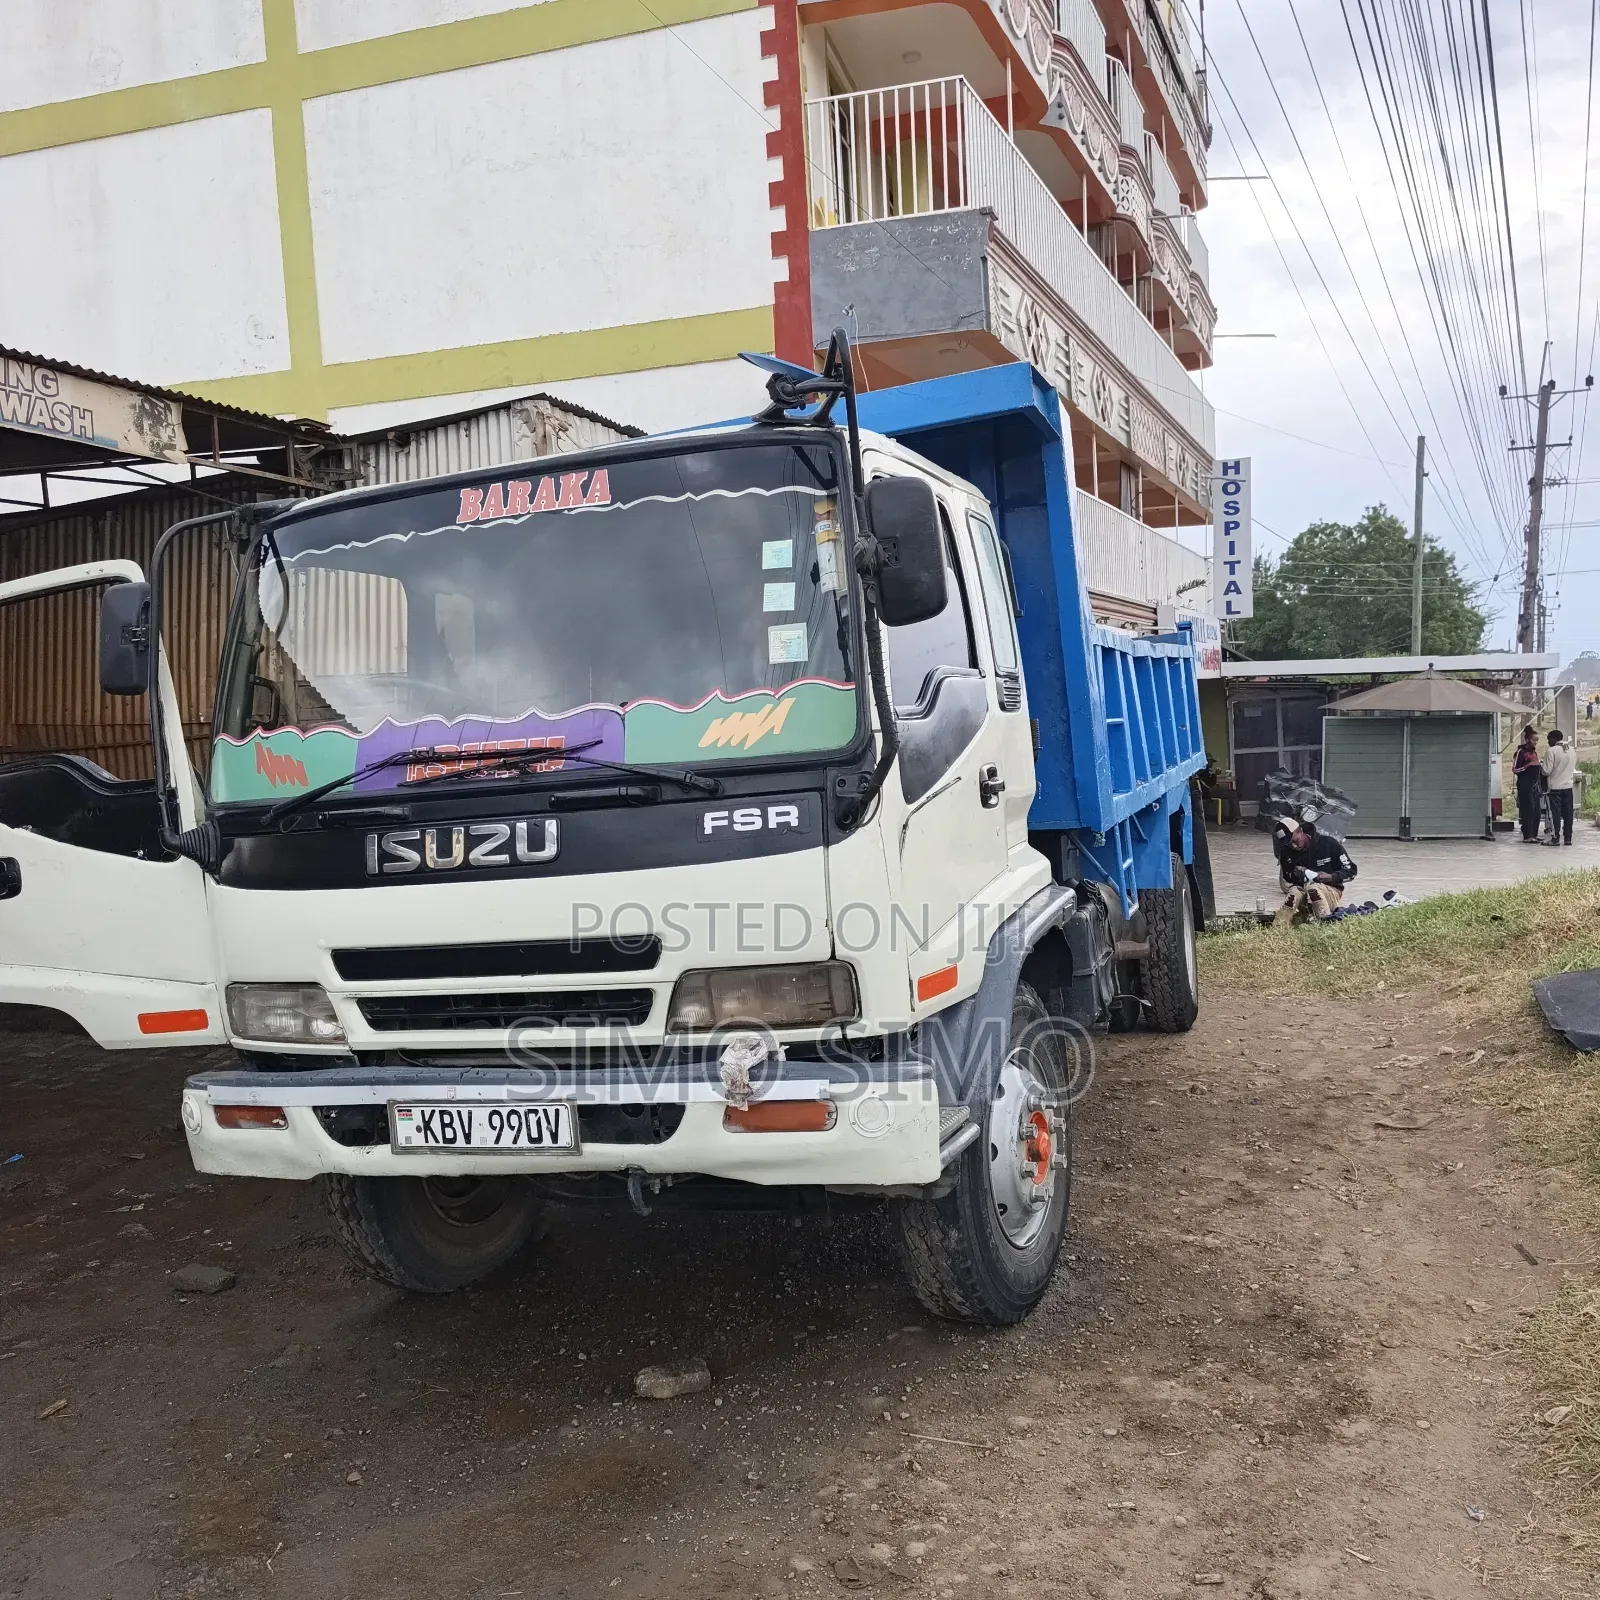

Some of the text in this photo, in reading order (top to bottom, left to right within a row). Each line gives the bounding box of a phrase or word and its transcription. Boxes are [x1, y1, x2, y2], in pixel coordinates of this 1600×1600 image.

[0, 387, 95, 441] WASH
[456, 469, 612, 524] BARAKA
[1221, 460, 1242, 616] HOSPITAL
[366, 819, 559, 875] ISUZU
[703, 805, 799, 835] FSR
[420, 1107, 561, 1145] KBV 990V
